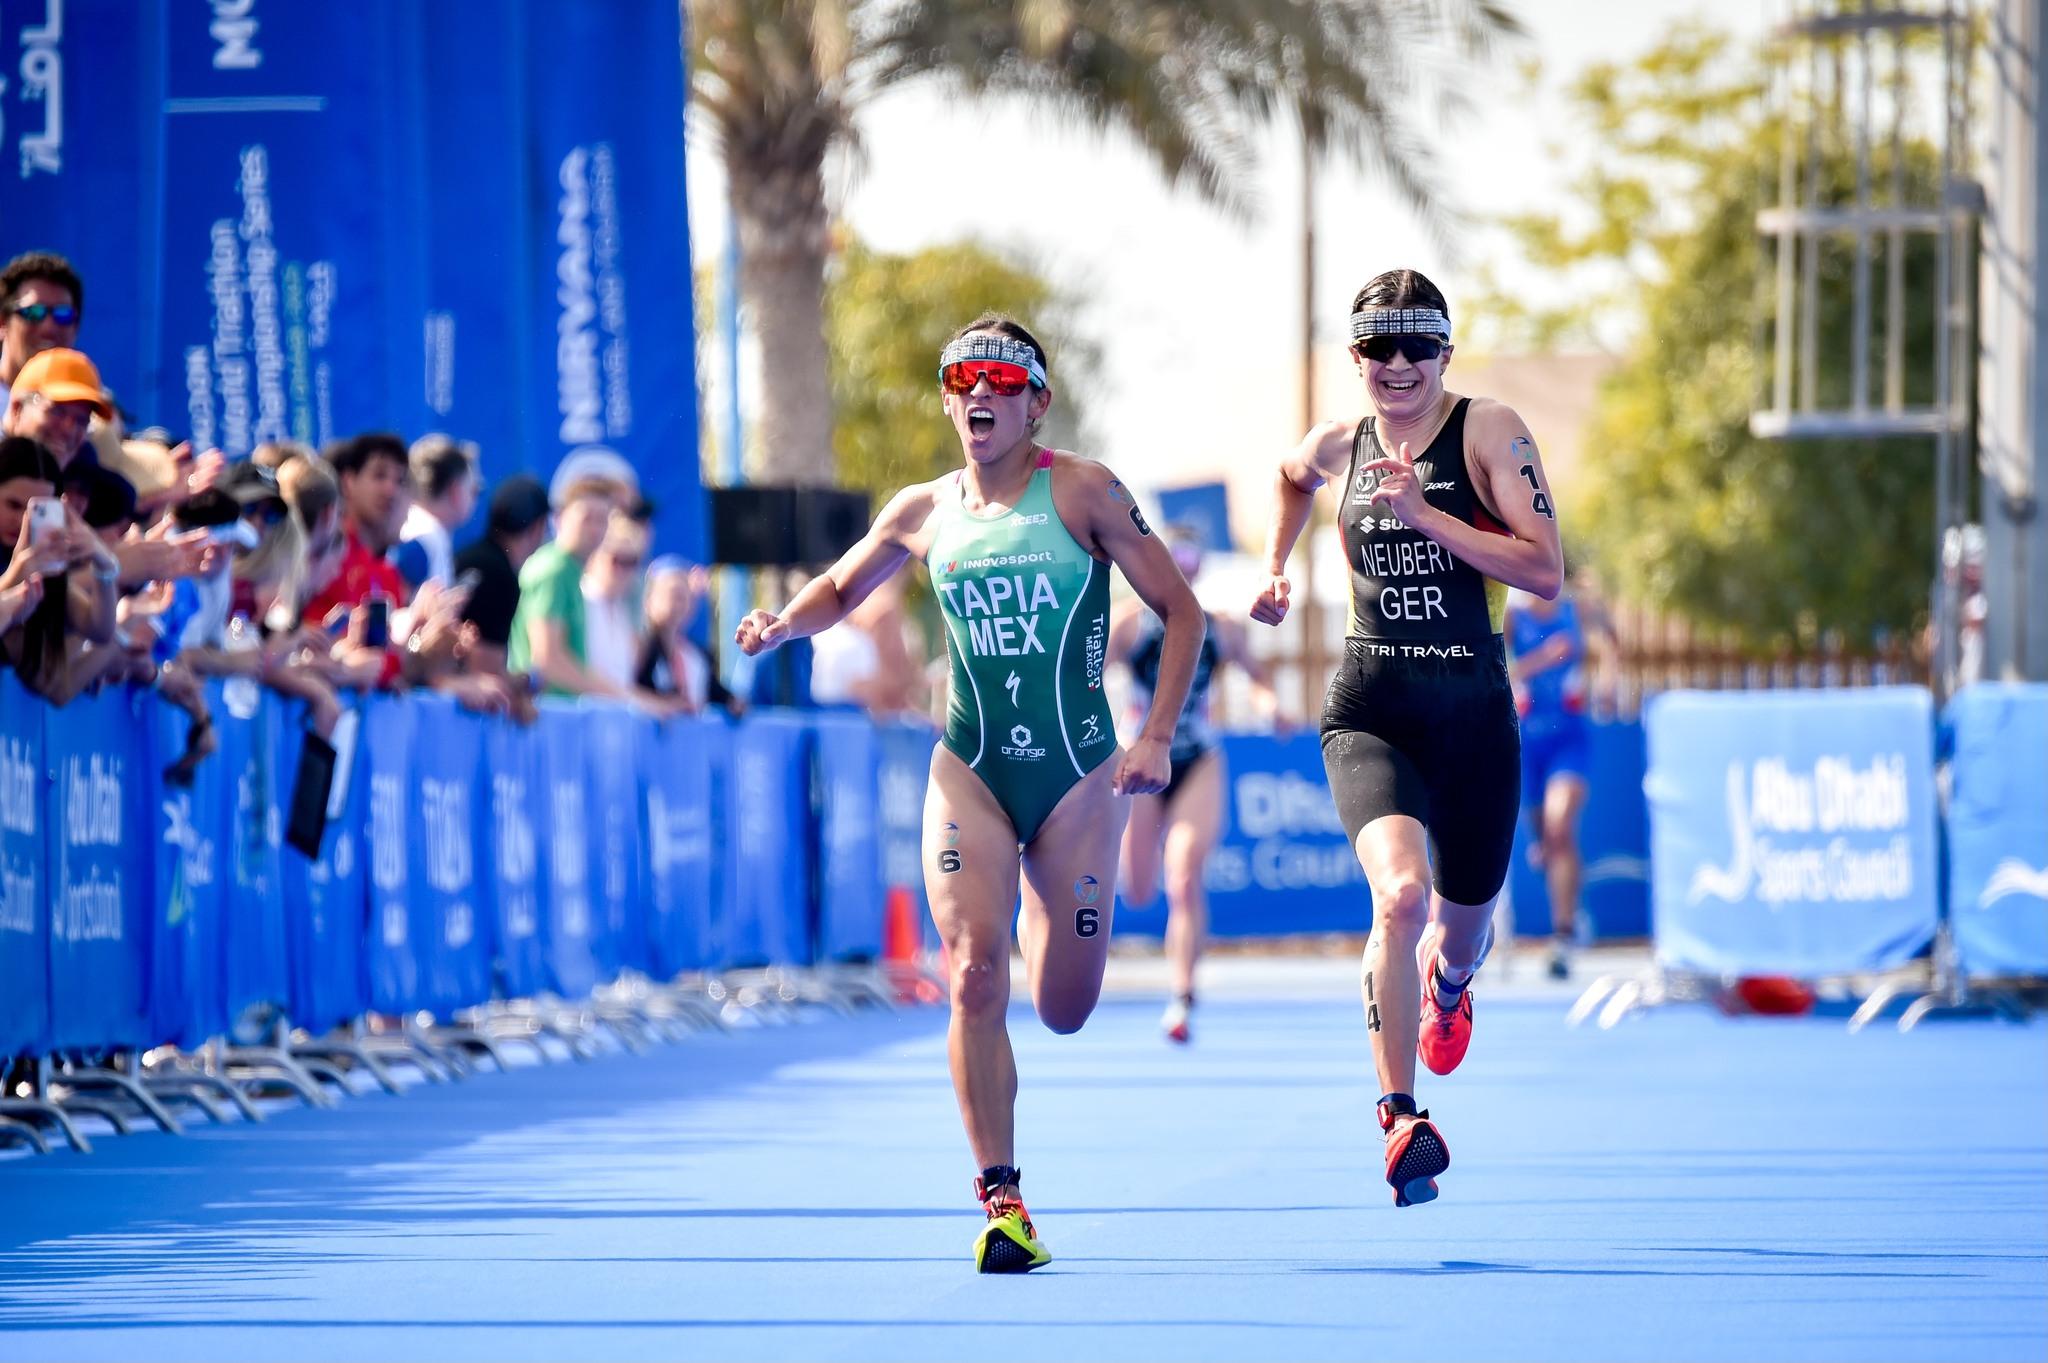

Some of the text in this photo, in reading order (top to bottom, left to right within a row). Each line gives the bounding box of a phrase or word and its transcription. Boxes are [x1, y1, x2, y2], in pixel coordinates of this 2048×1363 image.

[1518, 464, 1555, 520] 14
[939, 573, 1060, 618] TAPIA
[1380, 586, 1448, 620] GER
[967, 614, 1046, 656] MEX
[1368, 644, 1474, 659] TRI TRAVEL
[1814, 754, 1908, 832] Dhabi
[937, 849, 962, 874] 6
[1074, 907, 1100, 938] 6
[1364, 971, 1381, 1032] 14
